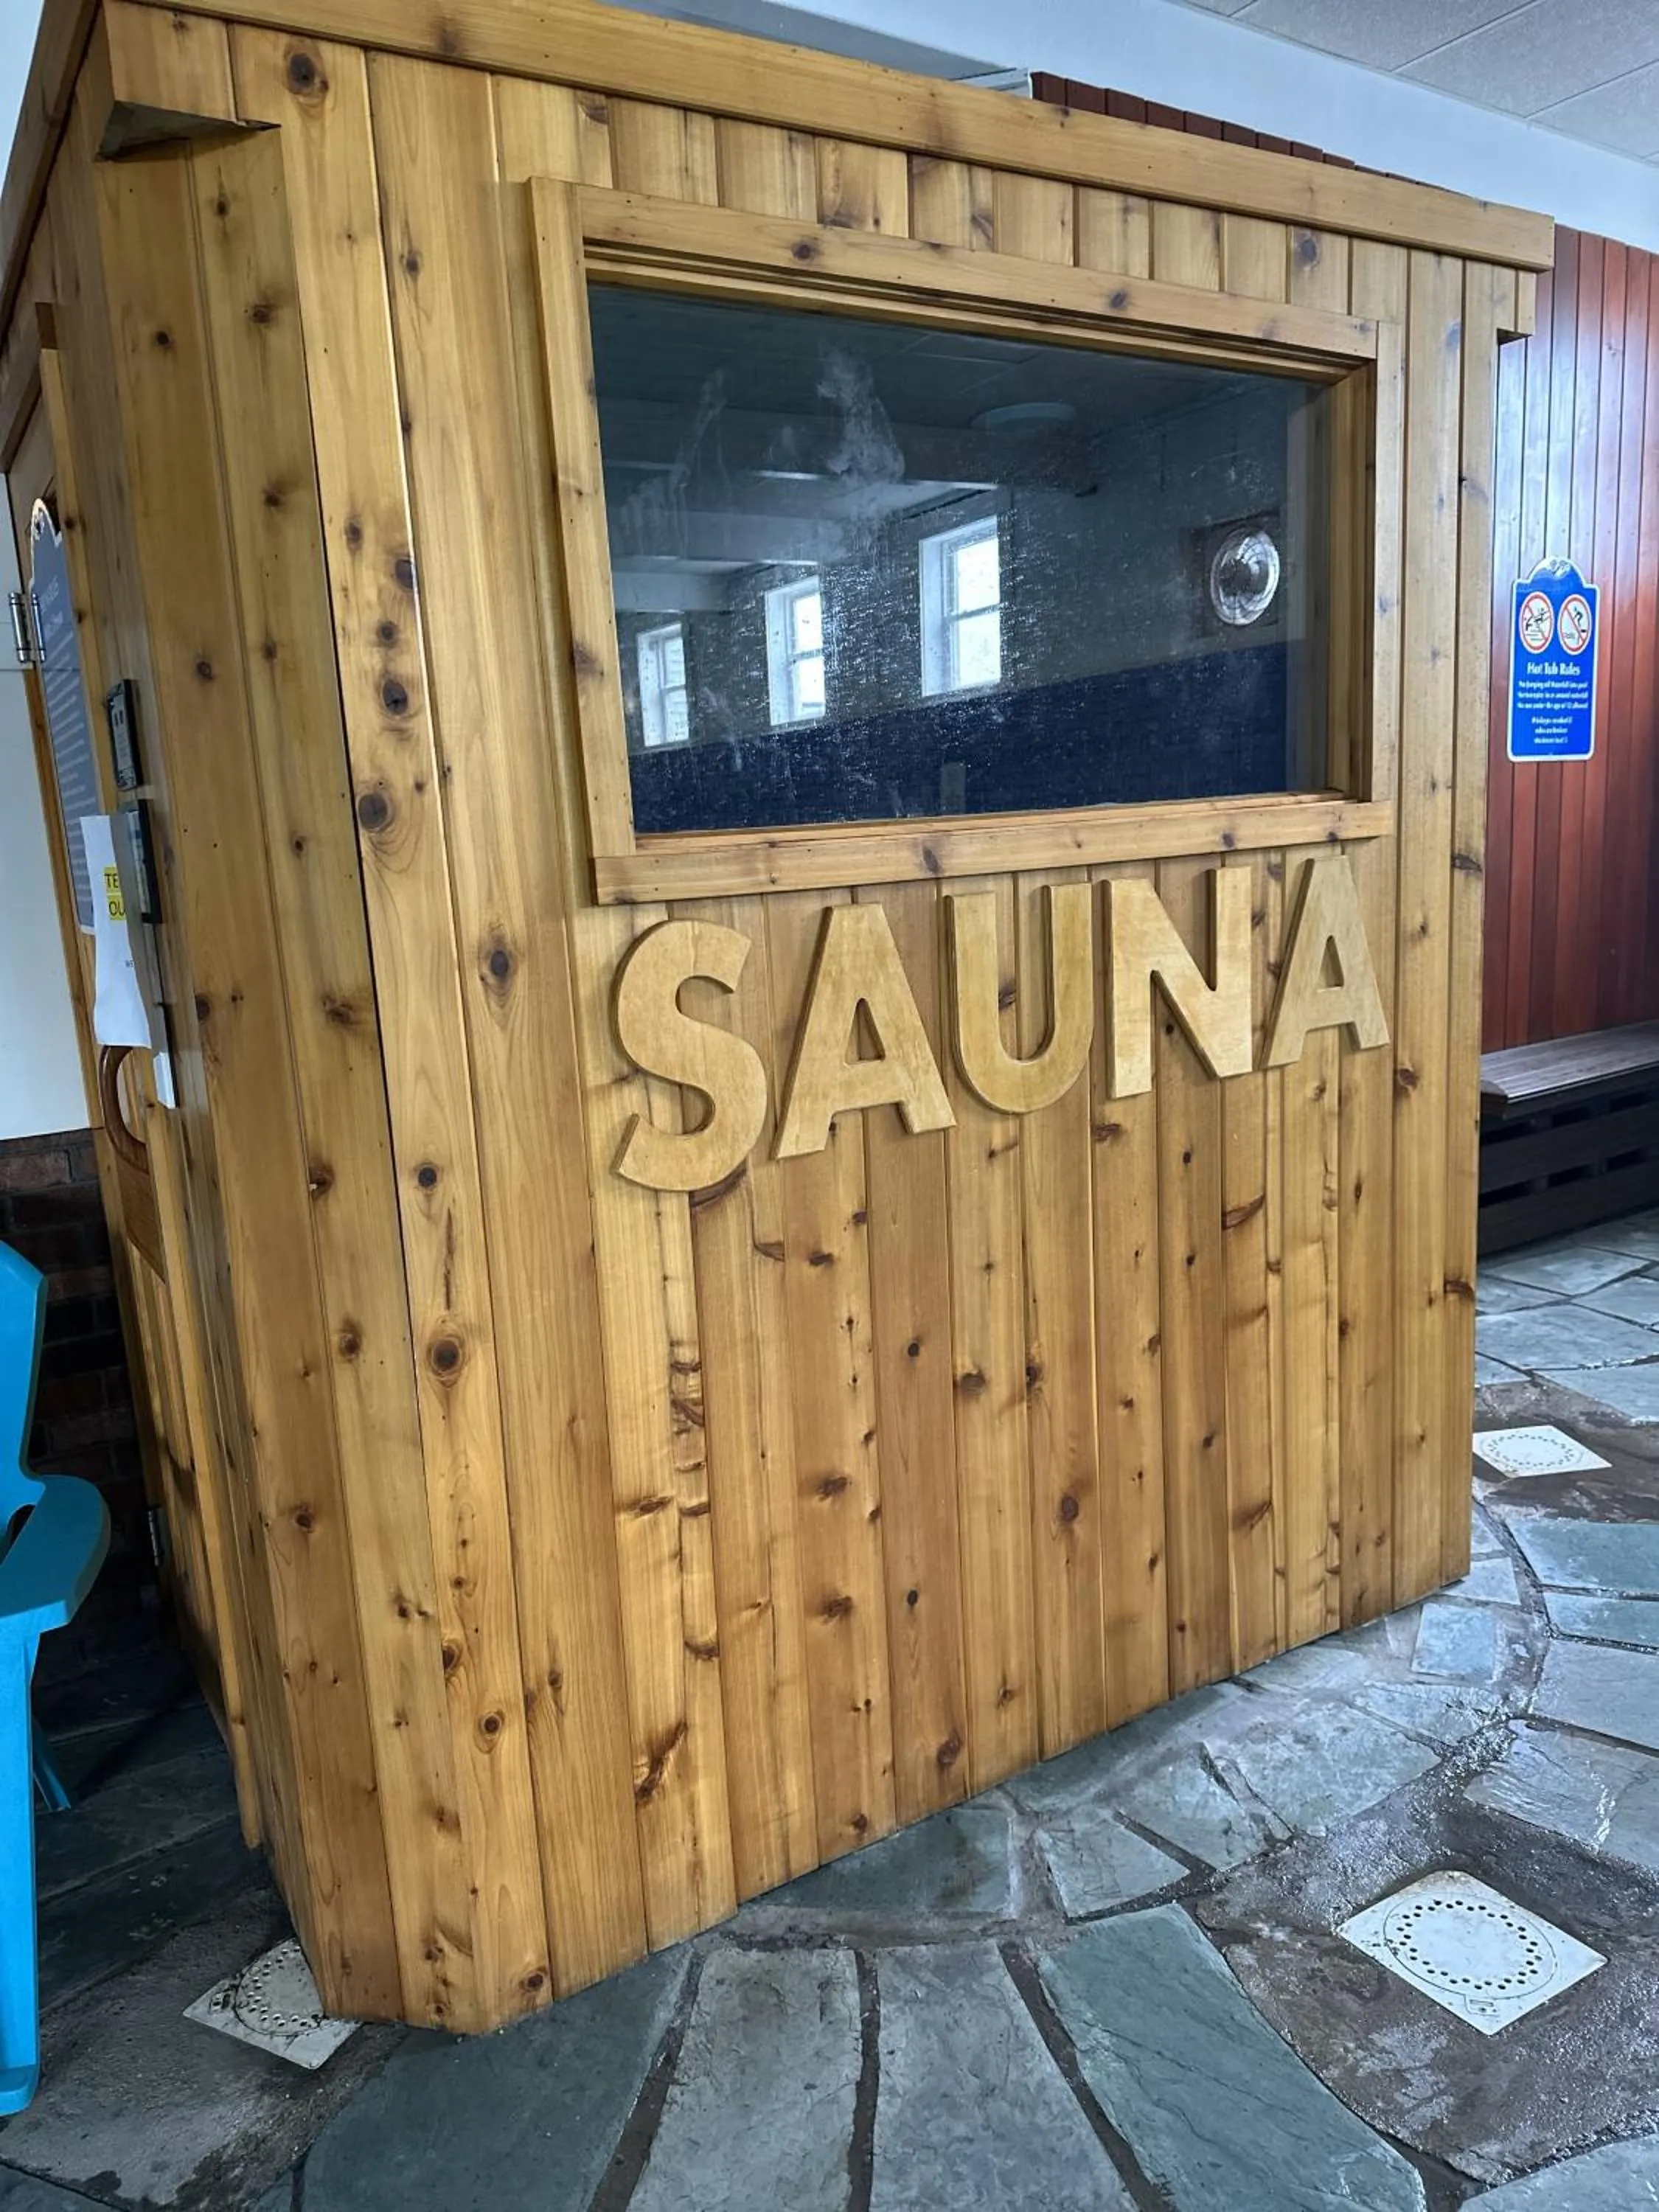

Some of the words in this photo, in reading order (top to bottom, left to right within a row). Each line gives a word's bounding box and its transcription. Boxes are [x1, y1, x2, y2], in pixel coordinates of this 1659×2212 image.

[1527, 661, 1543, 675] Hot
[1545, 661, 1558, 675] Tub
[1559, 662, 1580, 675] Rules
[616, 855, 1390, 1192] SAUNA
